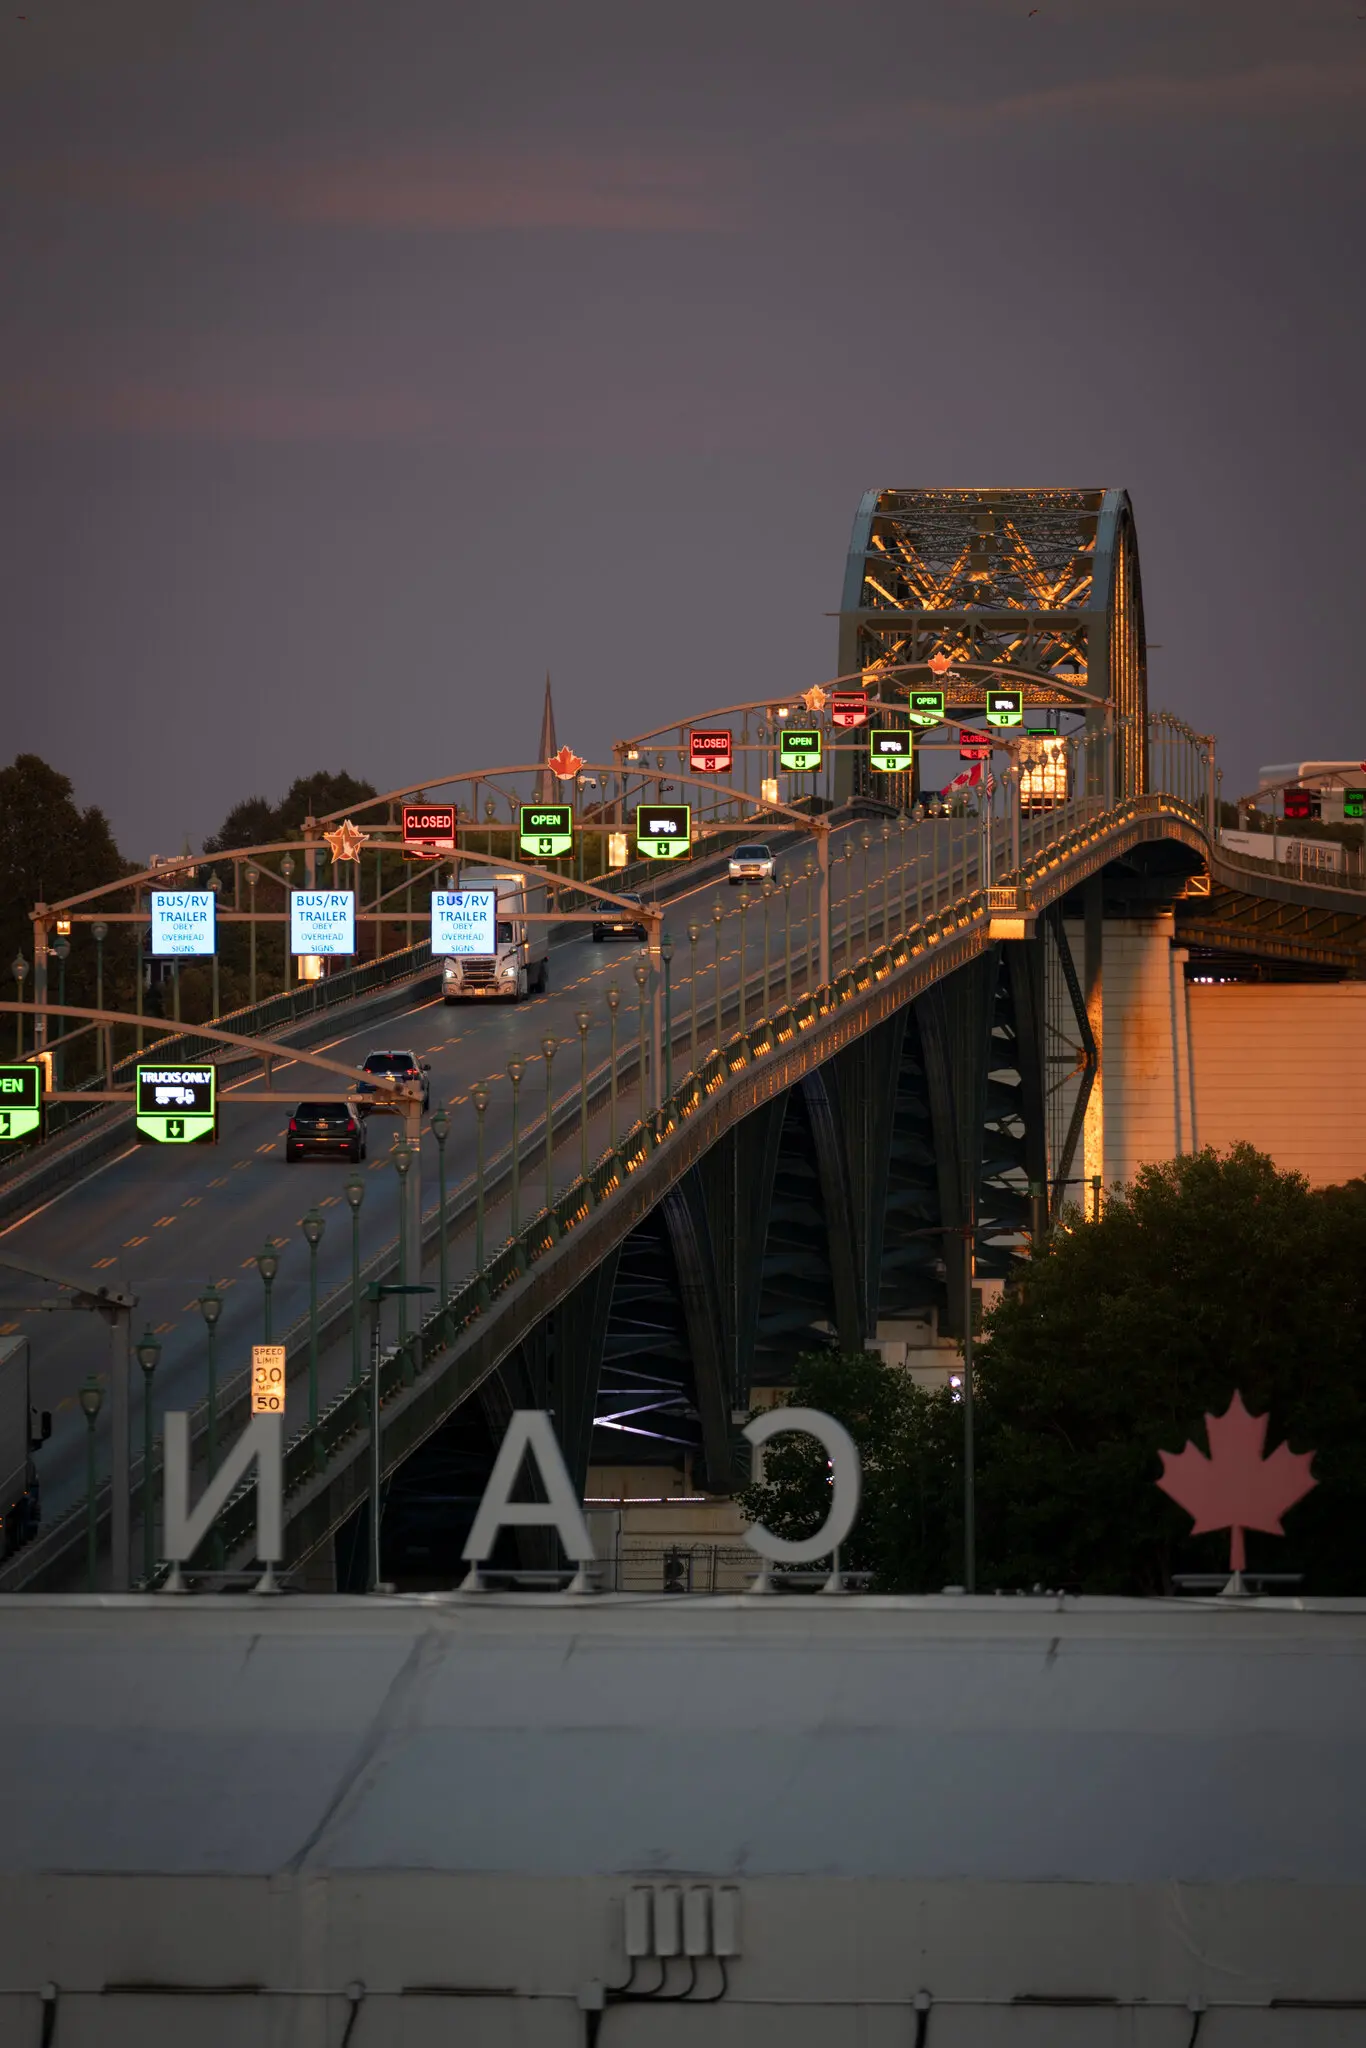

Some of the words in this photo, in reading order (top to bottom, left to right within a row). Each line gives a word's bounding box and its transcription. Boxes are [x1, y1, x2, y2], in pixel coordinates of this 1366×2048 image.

[916, 697, 938, 705] OPEN
[693, 738, 728, 749] CLOSED
[788, 737, 813, 746] OPEN
[407, 815, 451, 828] CLOSED
[530, 814, 561, 826] OPEN
[157, 894, 209, 908] BUS/RV
[296, 894, 349, 908] BUS/RV
[436, 894, 489, 908] BUS/RV
[159, 911, 207, 922] TRAILER
[298, 911, 347, 922] TRAILER
[438, 911, 487, 921] TRAILER
[172, 923, 193, 931] OBEY
[312, 922, 333, 930] OBEY
[452, 922, 473, 930] OBEY
[162, 933, 204, 941] OVERHEAD
[301, 933, 344, 941] OVERHEAD
[441, 933, 484, 941] OVERHEAD
[311, 944, 334, 952] SIGNS
[451, 944, 475, 952] SIGNS
[140, 1071, 182, 1083] TRUCKS
[181, 1071, 211, 1083] ONLY
[0, 1078, 24, 1093] EN
[254, 1348, 283, 1356] SPEED
[256, 1357, 280, 1365] LIMIT
[255, 1367, 282, 1384] 30
[257, 1397, 280, 1410] 50
